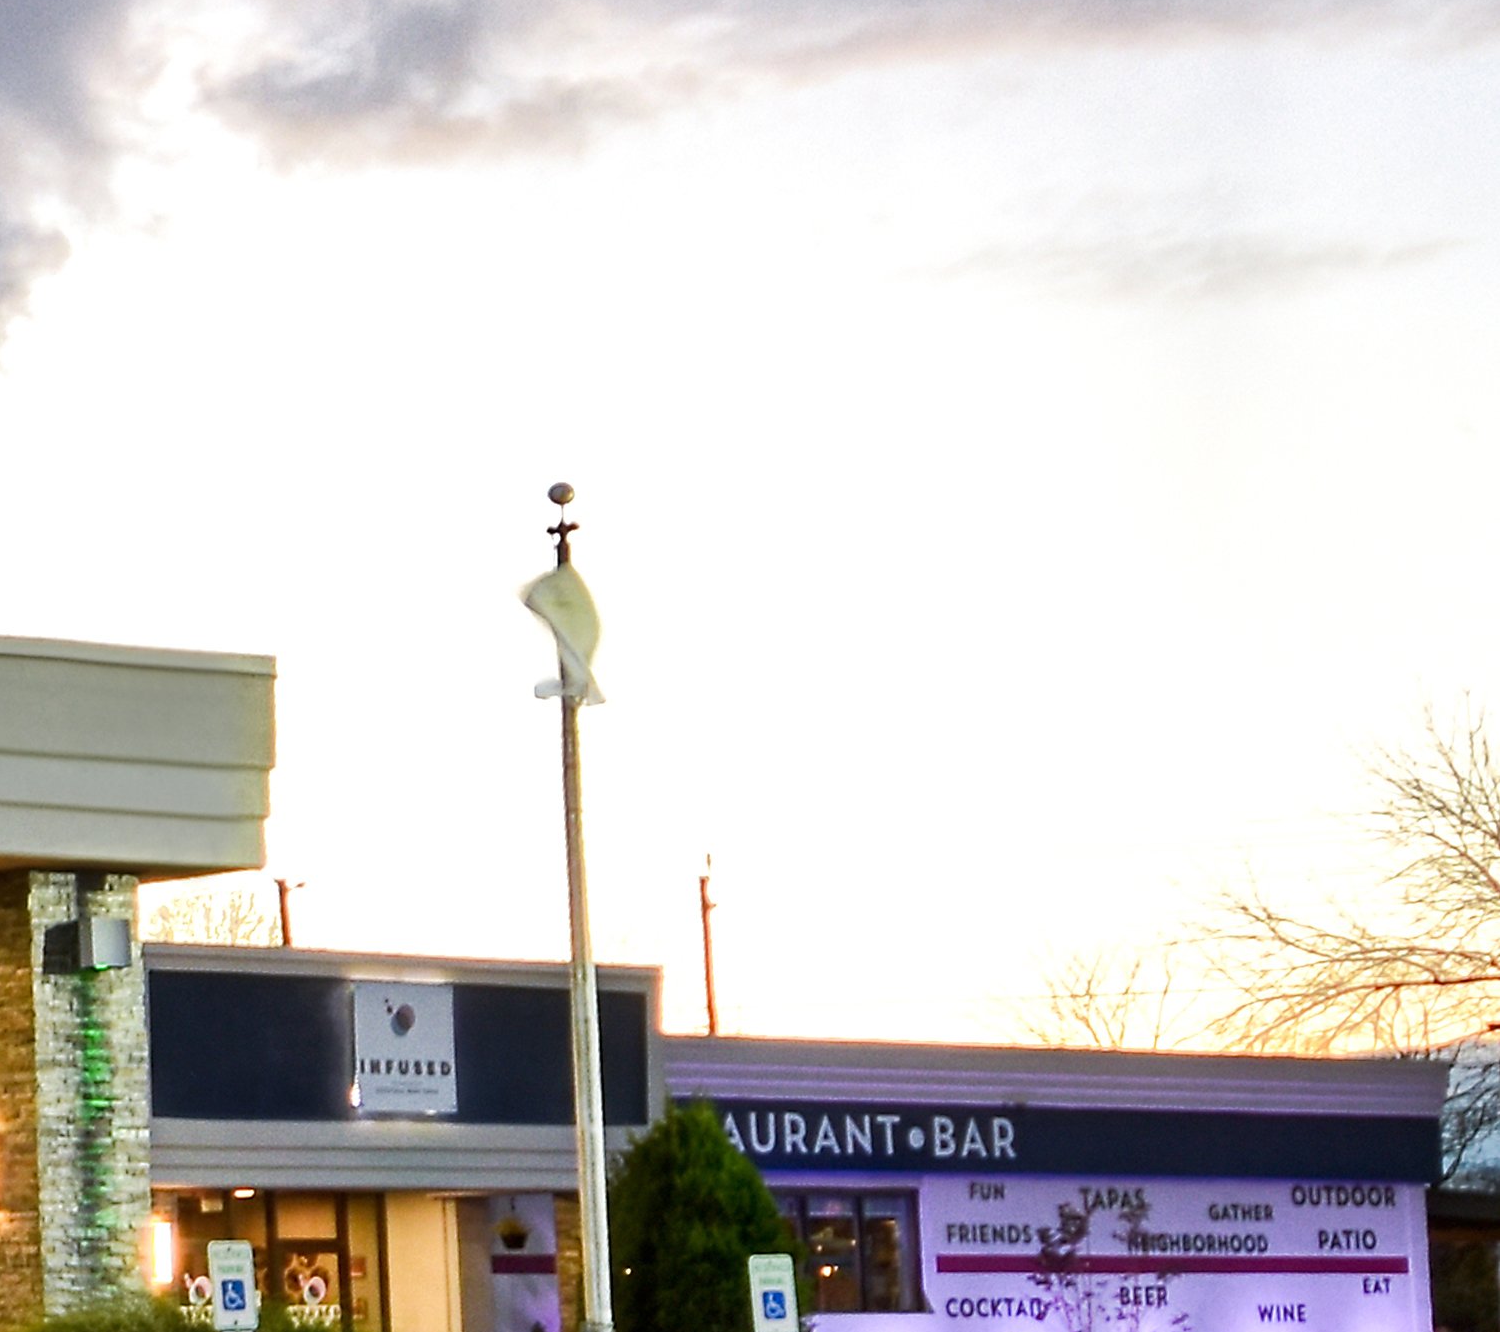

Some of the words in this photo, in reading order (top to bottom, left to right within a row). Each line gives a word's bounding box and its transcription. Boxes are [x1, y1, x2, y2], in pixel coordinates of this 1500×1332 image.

[359, 1058, 451, 1076] INFUSED
[933, 1115, 1017, 1158] BAR
[969, 1182, 1005, 1200] FUN
[1079, 1188, 1146, 1210] TAPAS
[1291, 1185, 1395, 1207] OUTDOOR
[1208, 1203, 1273, 1221] GATHER
[947, 1224, 1032, 1244] FRIENDS
[1318, 1230, 1377, 1250] PATIO
[1119, 1286, 1168, 1306] BEER
[1363, 1278, 1391, 1294] EAT
[1258, 1304, 1307, 1322] WINE
